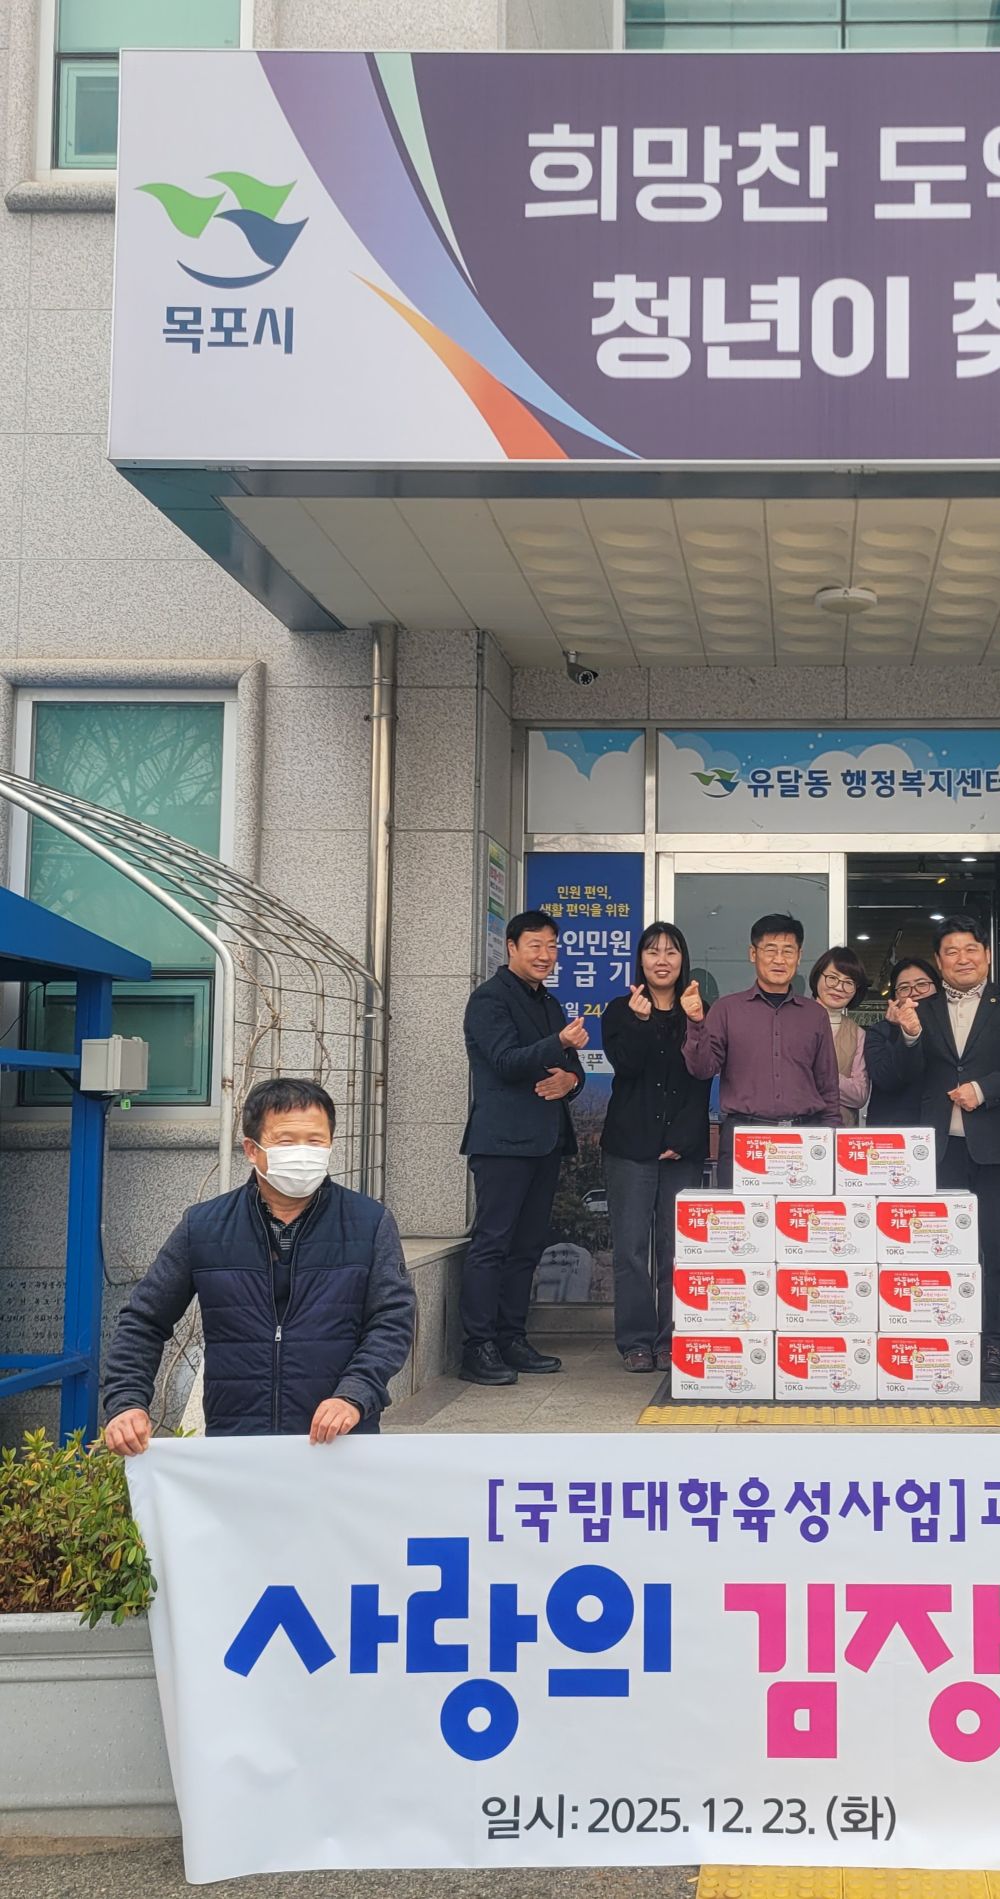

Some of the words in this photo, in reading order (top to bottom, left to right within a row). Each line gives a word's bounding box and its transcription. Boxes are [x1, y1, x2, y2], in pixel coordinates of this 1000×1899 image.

[525, 123, 839, 222] 희망찬
[162, 306, 295, 355] 목포시
[591, 273, 910, 380] 청년이
[746, 767, 833, 800] 유달동
[557, 885, 582, 900] 민원
[584, 885, 612, 900] 편익,
[538, 903, 564, 918] 생활
[566, 903, 603, 918] 편익을
[605, 903, 630, 918] 위한
[556, 930, 632, 957] 인민원
[848, 1151, 867, 1161] 키토
[741, 1179, 760, 1187] 10KG
[844, 1180, 863, 1188] 10KG
[688, 1218, 708, 1229] 키토
[789, 1218, 809, 1229] 키토
[890, 1219, 910, 1229] 키토
[684, 1247, 703, 1255] 10KG
[784, 1247, 804, 1255] 10KG
[688, 1286, 708, 1296] 키토
[790, 1286, 809, 1297] 키토
[893, 1287, 911, 1298] 키토
[685, 1353, 705, 1364] 키토
[789, 1354, 808, 1365] 키토
[680, 1383, 699, 1391] 10KG
[886, 1384, 906, 1392] 10KG
[223, 1537, 672, 1762] 사랑의
[481, 1793, 580, 1840] 일시:
[587, 1796, 690, 1834] 2025.
[701, 1796, 753, 1834] 12.
[761, 1797, 816, 1836] 23.
[825, 1794, 897, 1842] (화)
